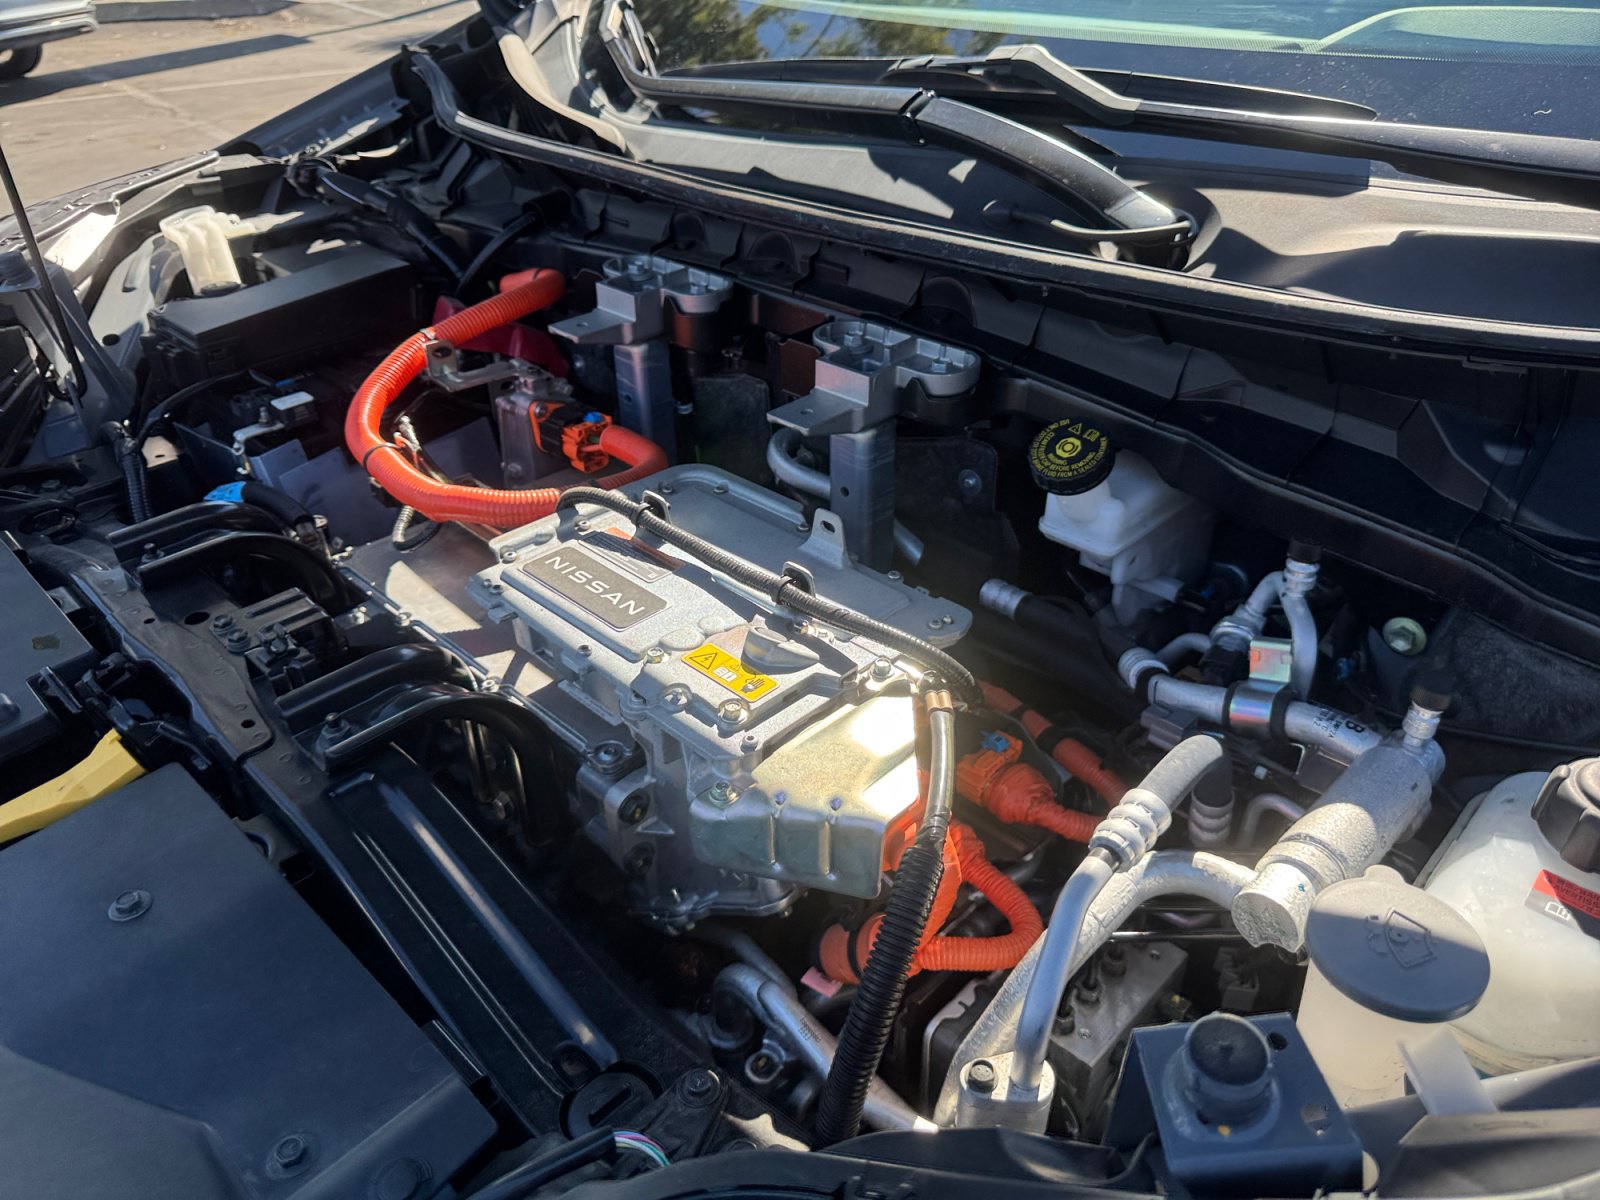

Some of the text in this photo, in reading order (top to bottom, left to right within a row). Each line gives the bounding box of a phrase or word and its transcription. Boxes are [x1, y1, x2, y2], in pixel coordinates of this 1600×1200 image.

[1049, 464, 1070, 472] BEFORE
[1071, 452, 1096, 469] REMOVING
[544, 556, 645, 616] NISSAN
[1346, 720, 1365, 733] B
